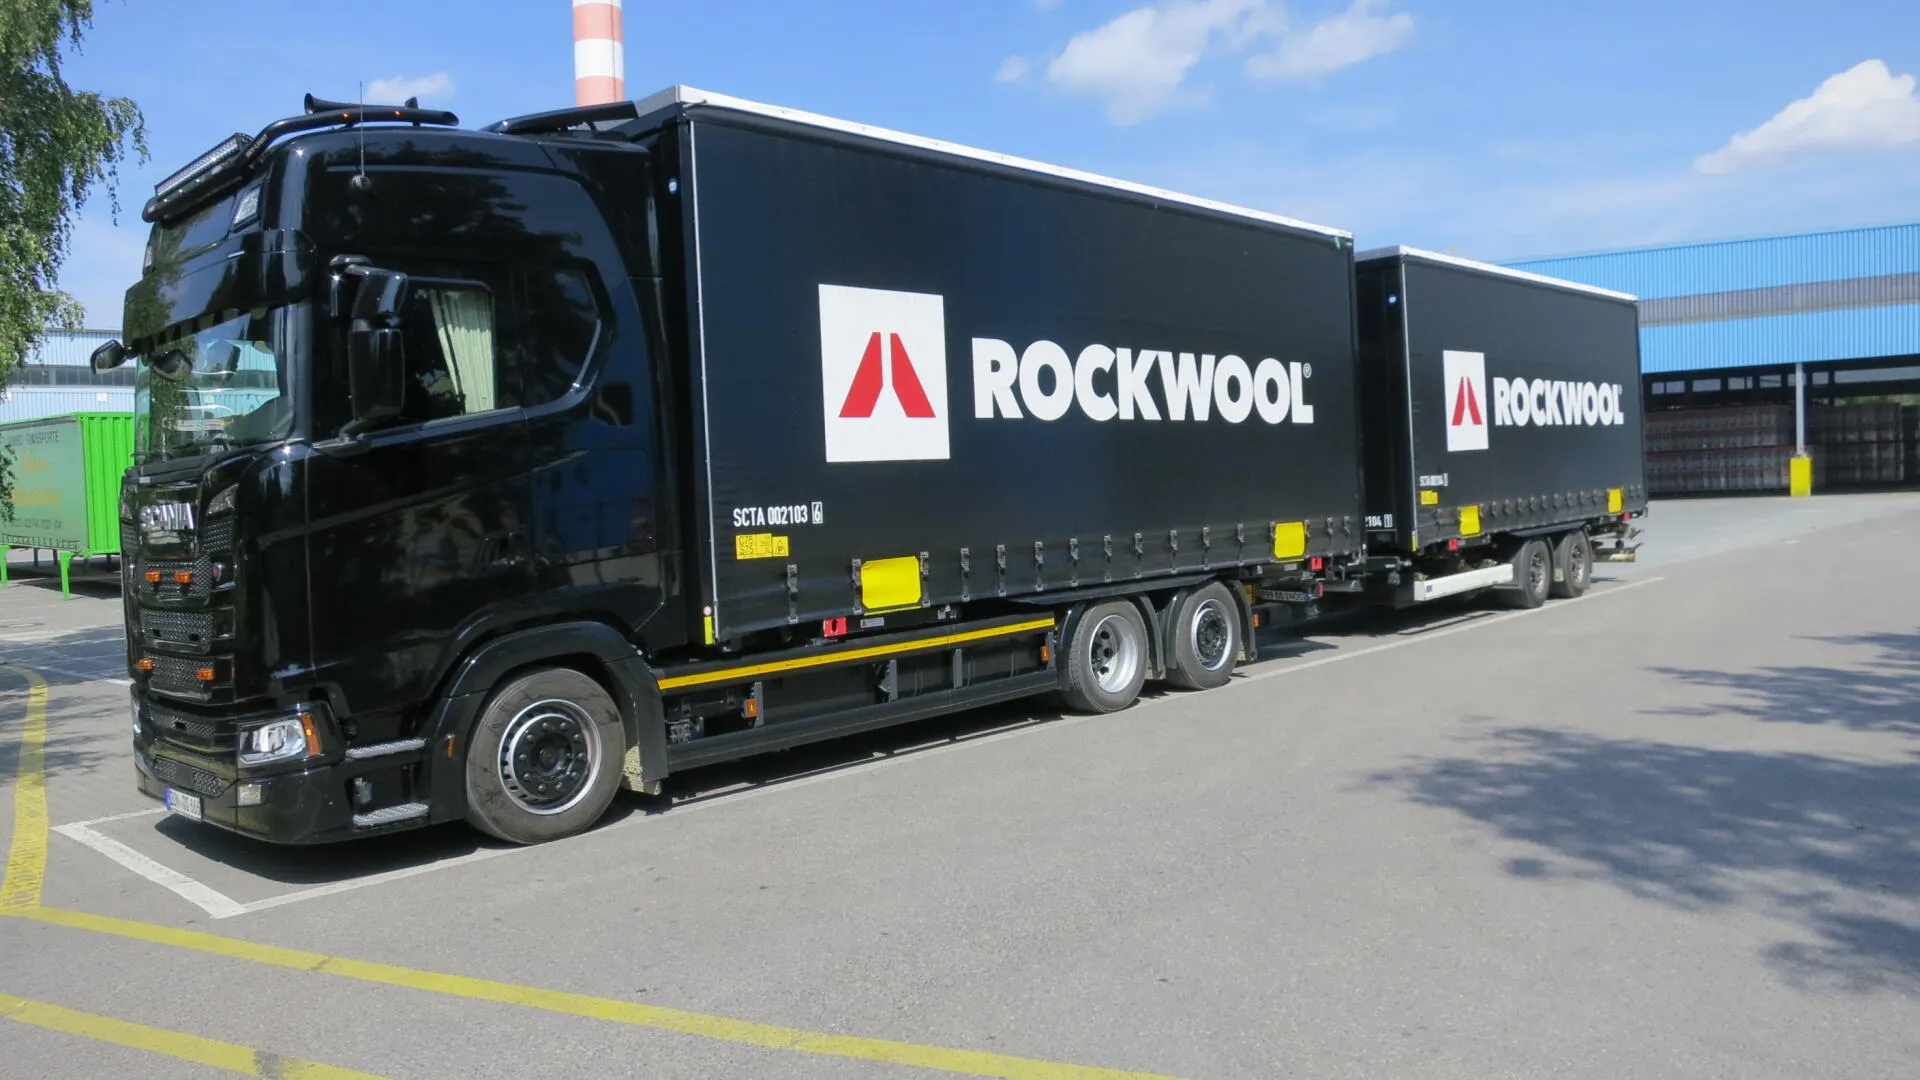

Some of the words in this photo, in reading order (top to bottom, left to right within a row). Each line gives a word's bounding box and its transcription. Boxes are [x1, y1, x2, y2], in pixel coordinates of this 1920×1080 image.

[140, 503, 194, 531] SCANIA
[733, 507, 765, 527] SCTA
[767, 504, 808, 525] 002103
[812, 502, 822, 523] 6
[738, 535, 753, 546] C75
